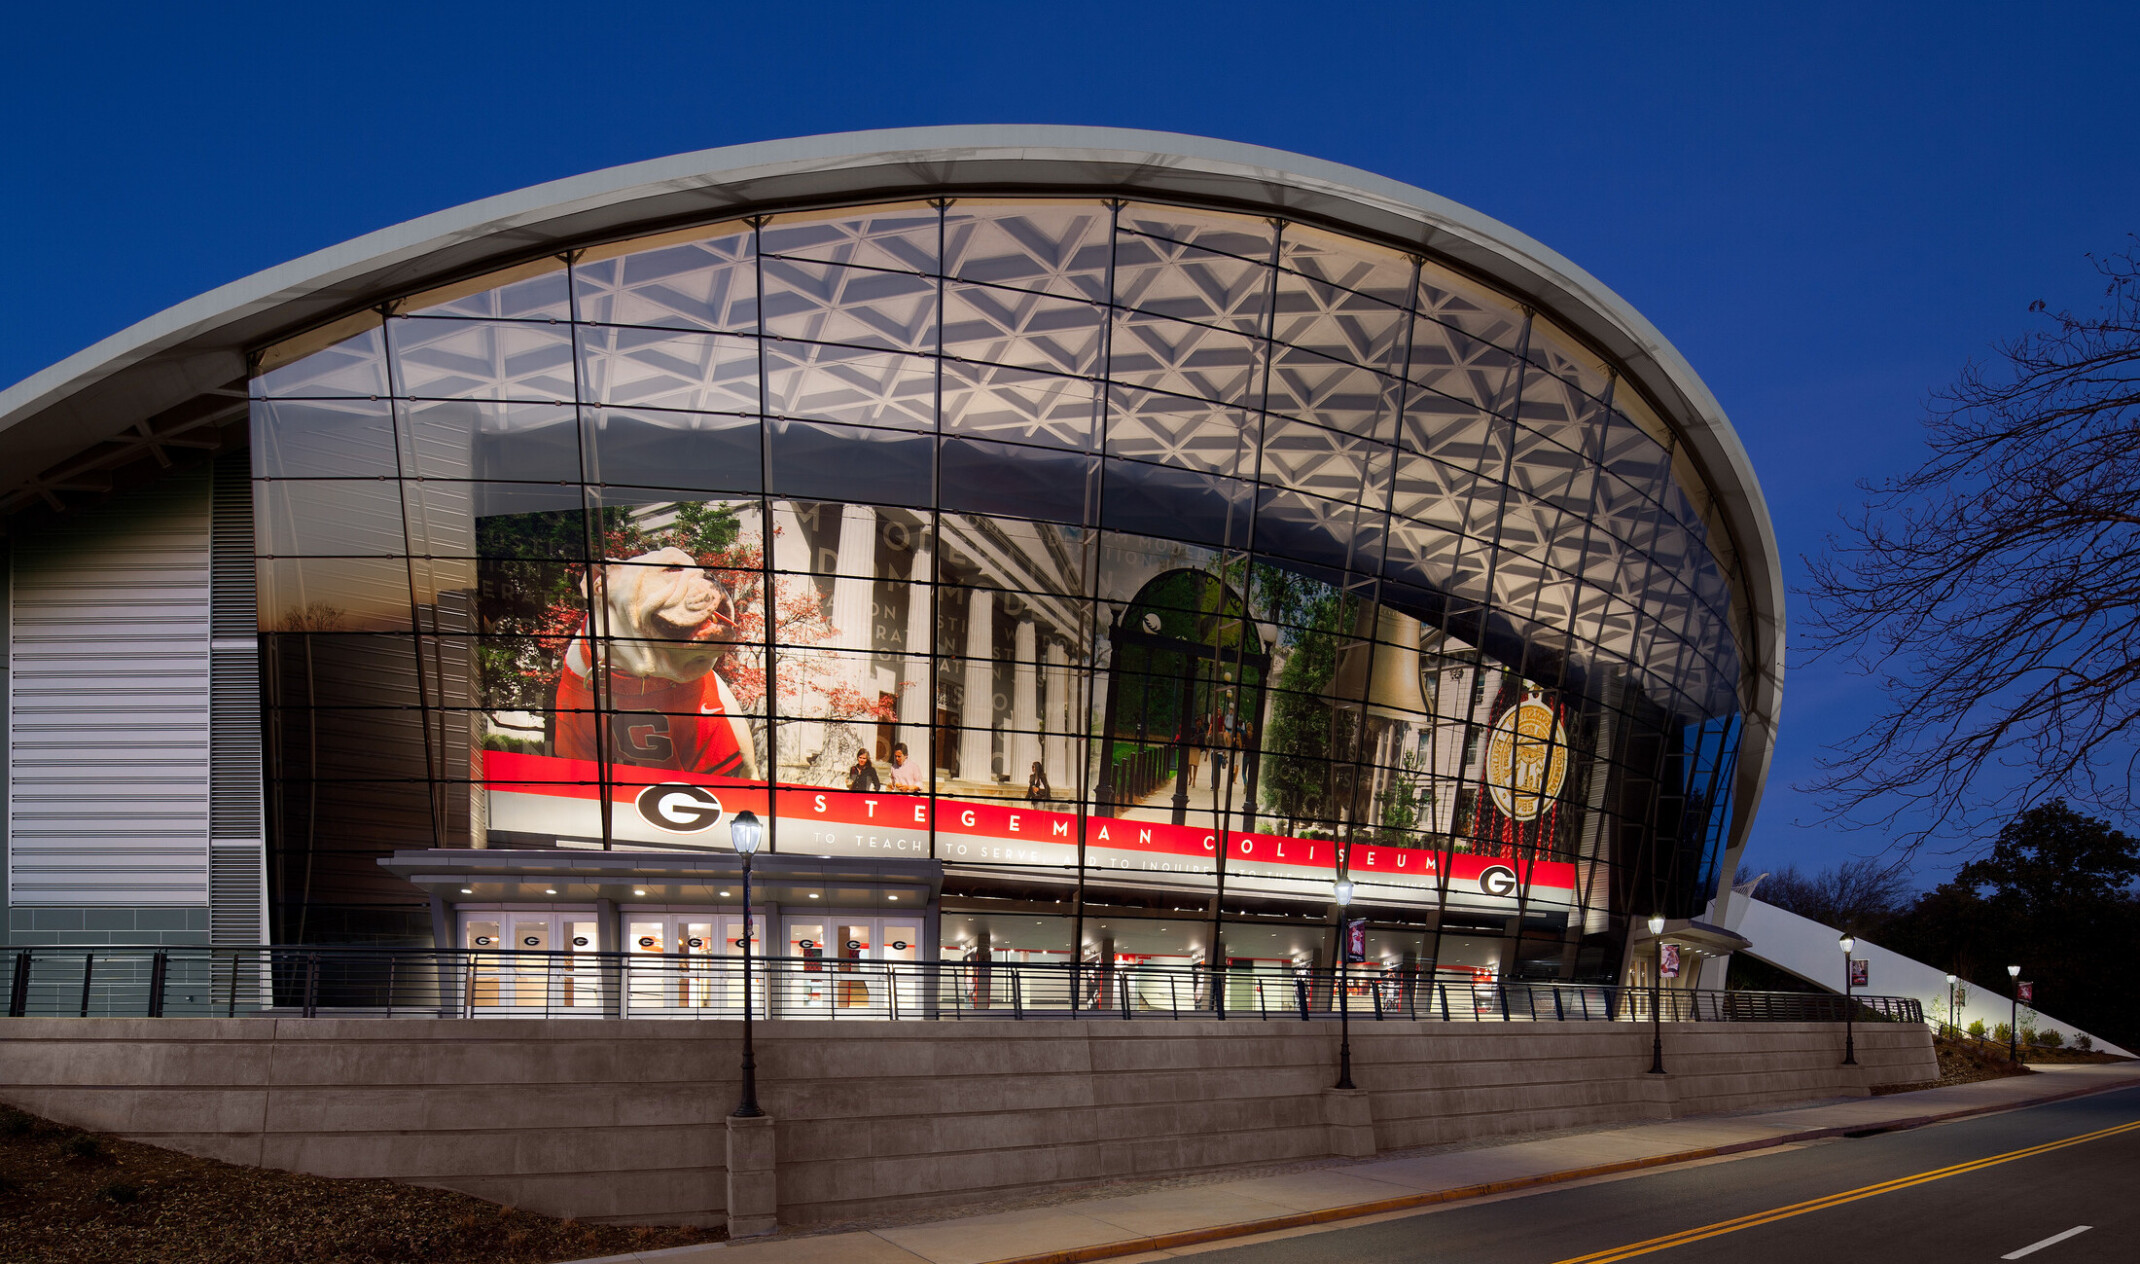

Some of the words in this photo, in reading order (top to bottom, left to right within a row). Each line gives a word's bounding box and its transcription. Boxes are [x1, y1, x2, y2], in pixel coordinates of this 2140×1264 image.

[613, 708, 674, 761] G
[635, 782, 722, 834] G
[813, 794, 1152, 845] STEGEMAN
[1203, 835, 1438, 870] COLISEUM
[813, 832, 836, 844] TO
[945, 843, 968, 855] TO
[1110, 858, 1130, 869] TO
[1479, 865, 1516, 896] G
[475, 936, 491, 946] G
[524, 936, 540, 946] G
[573, 936, 588, 947] G
[638, 937, 655, 947] G
[687, 938, 703, 948] G
[799, 939, 814, 949] G
[846, 940, 861, 950] G
[892, 940, 907, 950] G
